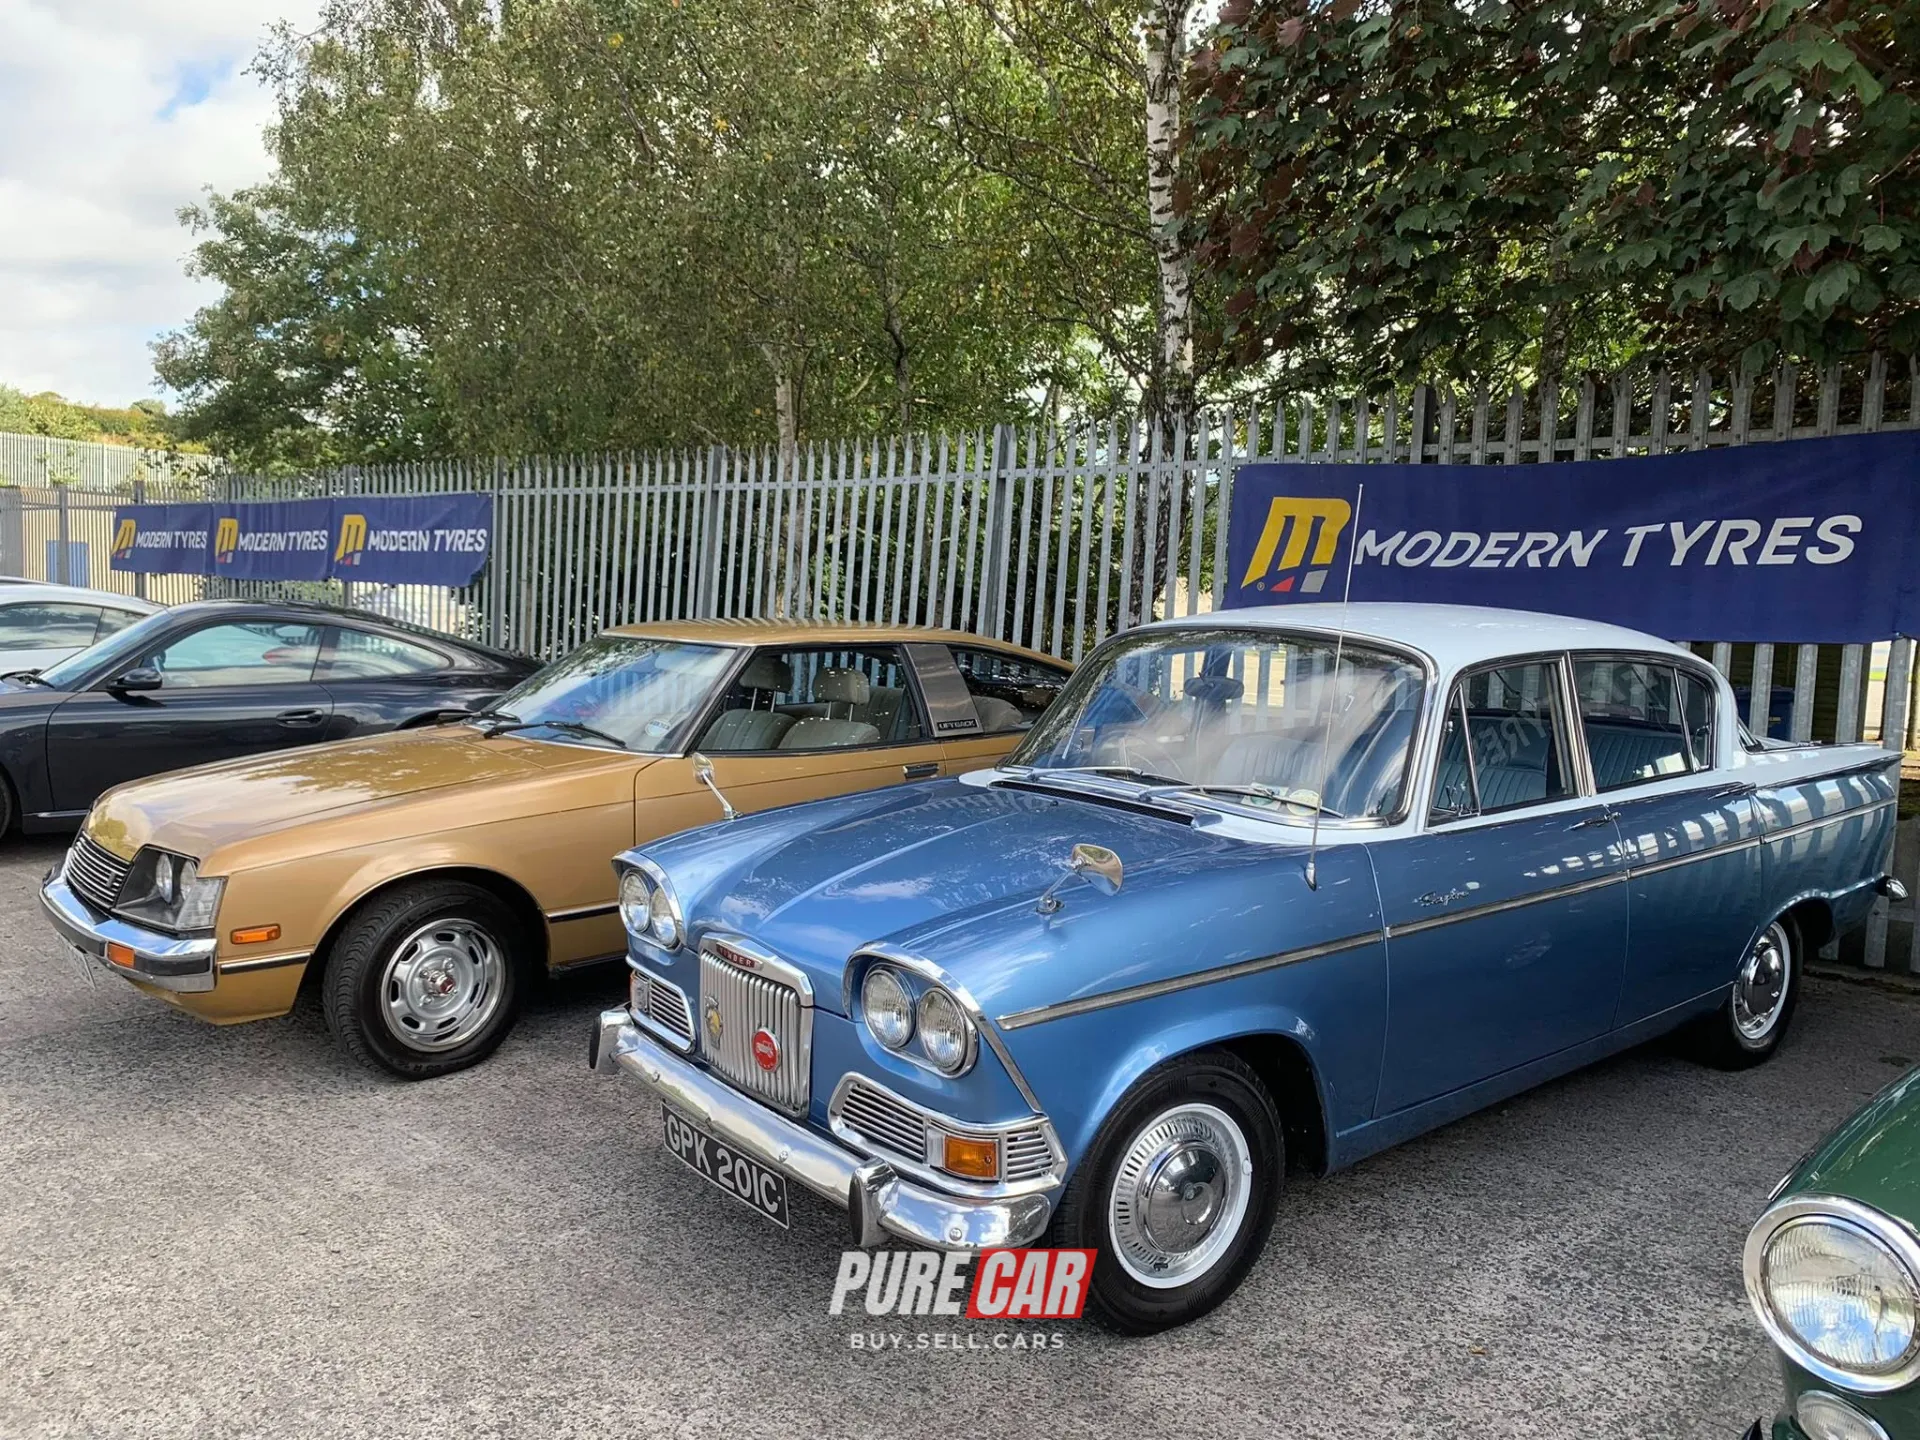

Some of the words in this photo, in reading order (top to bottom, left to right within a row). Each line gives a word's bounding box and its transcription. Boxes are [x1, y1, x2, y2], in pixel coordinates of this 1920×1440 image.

[135, 531, 172, 548] MODERN
[172, 530, 208, 549] TYRES
[238, 532, 290, 552] MODERN
[288, 530, 328, 551] TYRES
[367, 530, 430, 552] MODERN
[433, 528, 488, 552] TYRES
[1354, 529, 1608, 568] MODERN
[1622, 514, 1862, 567] TYRES
[667, 1114, 712, 1176] GPK
[716, 1148, 779, 1214] 201C
